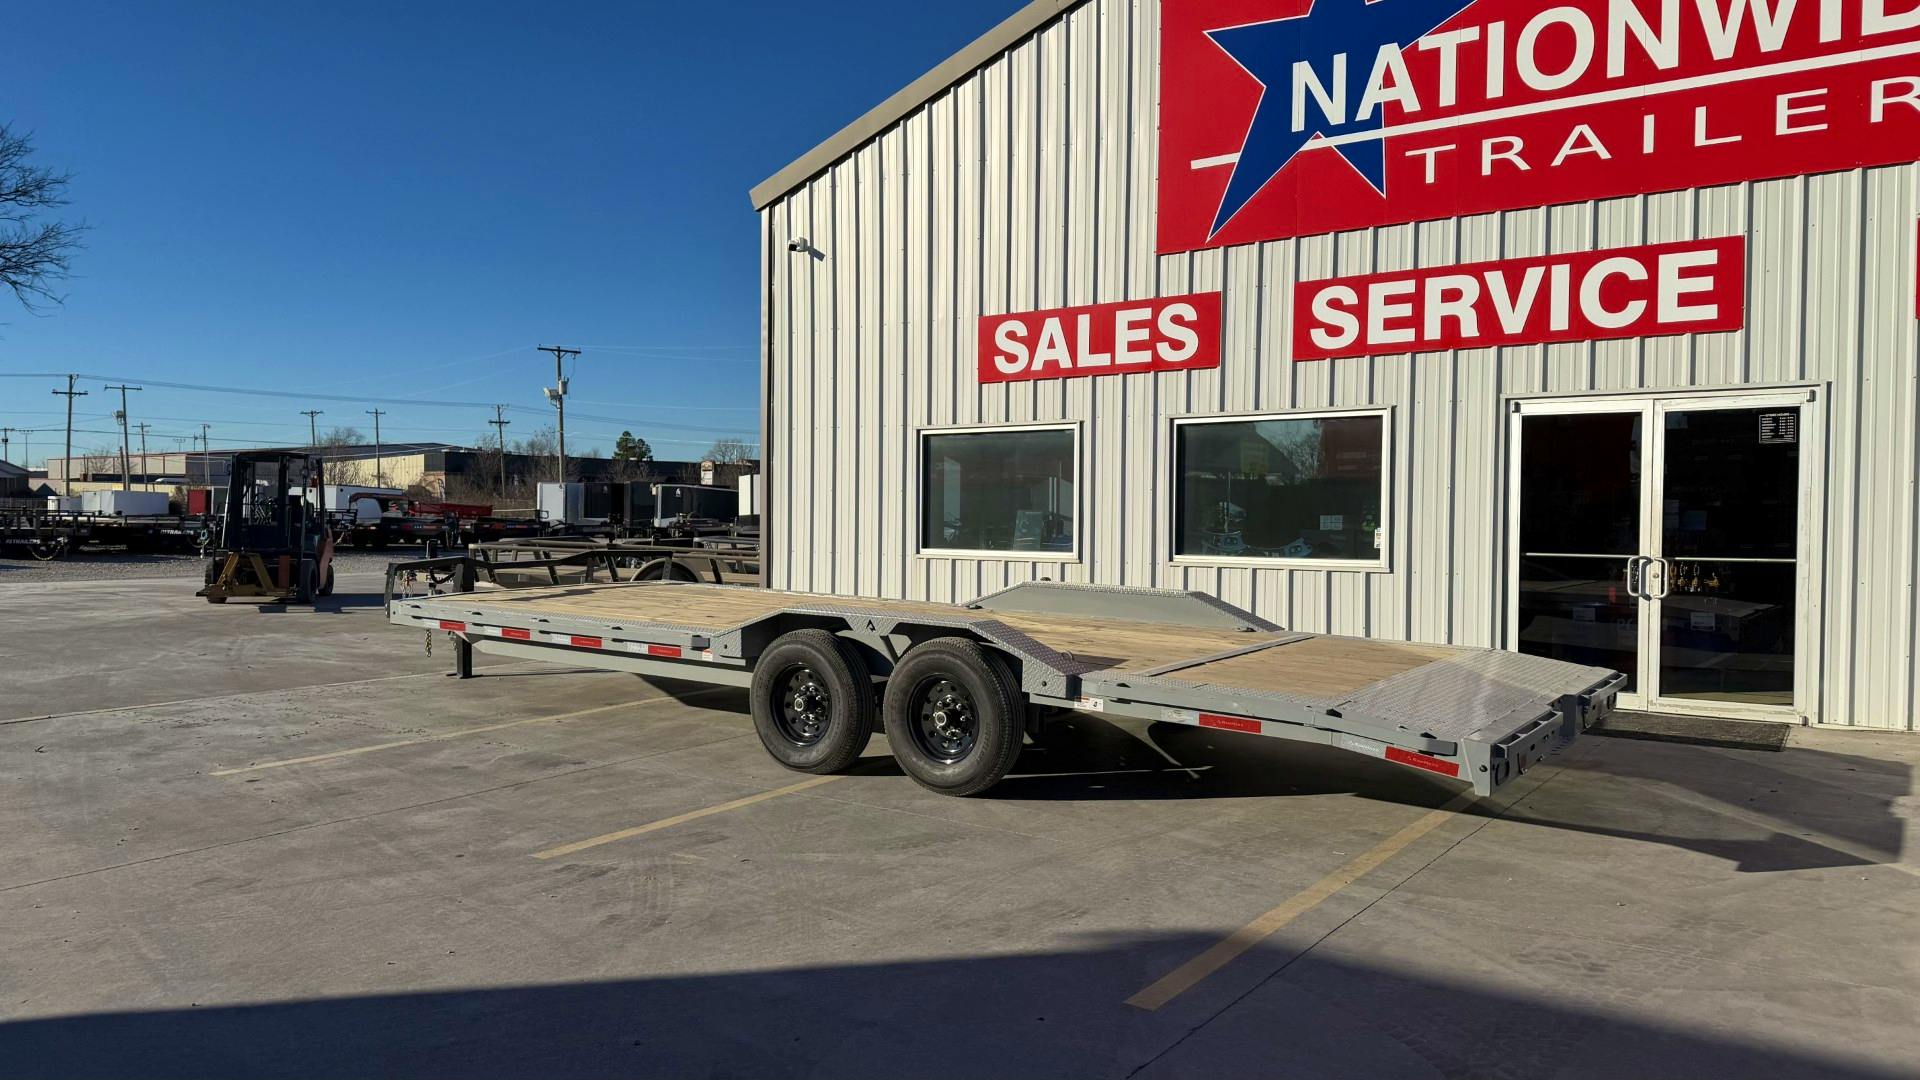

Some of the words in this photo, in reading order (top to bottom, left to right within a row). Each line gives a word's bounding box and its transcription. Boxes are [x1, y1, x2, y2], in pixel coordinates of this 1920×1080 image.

[1406, 76, 1920, 184] TRAILER
[994, 303, 1199, 374] SALES
[1310, 250, 1718, 350] SERVICE
